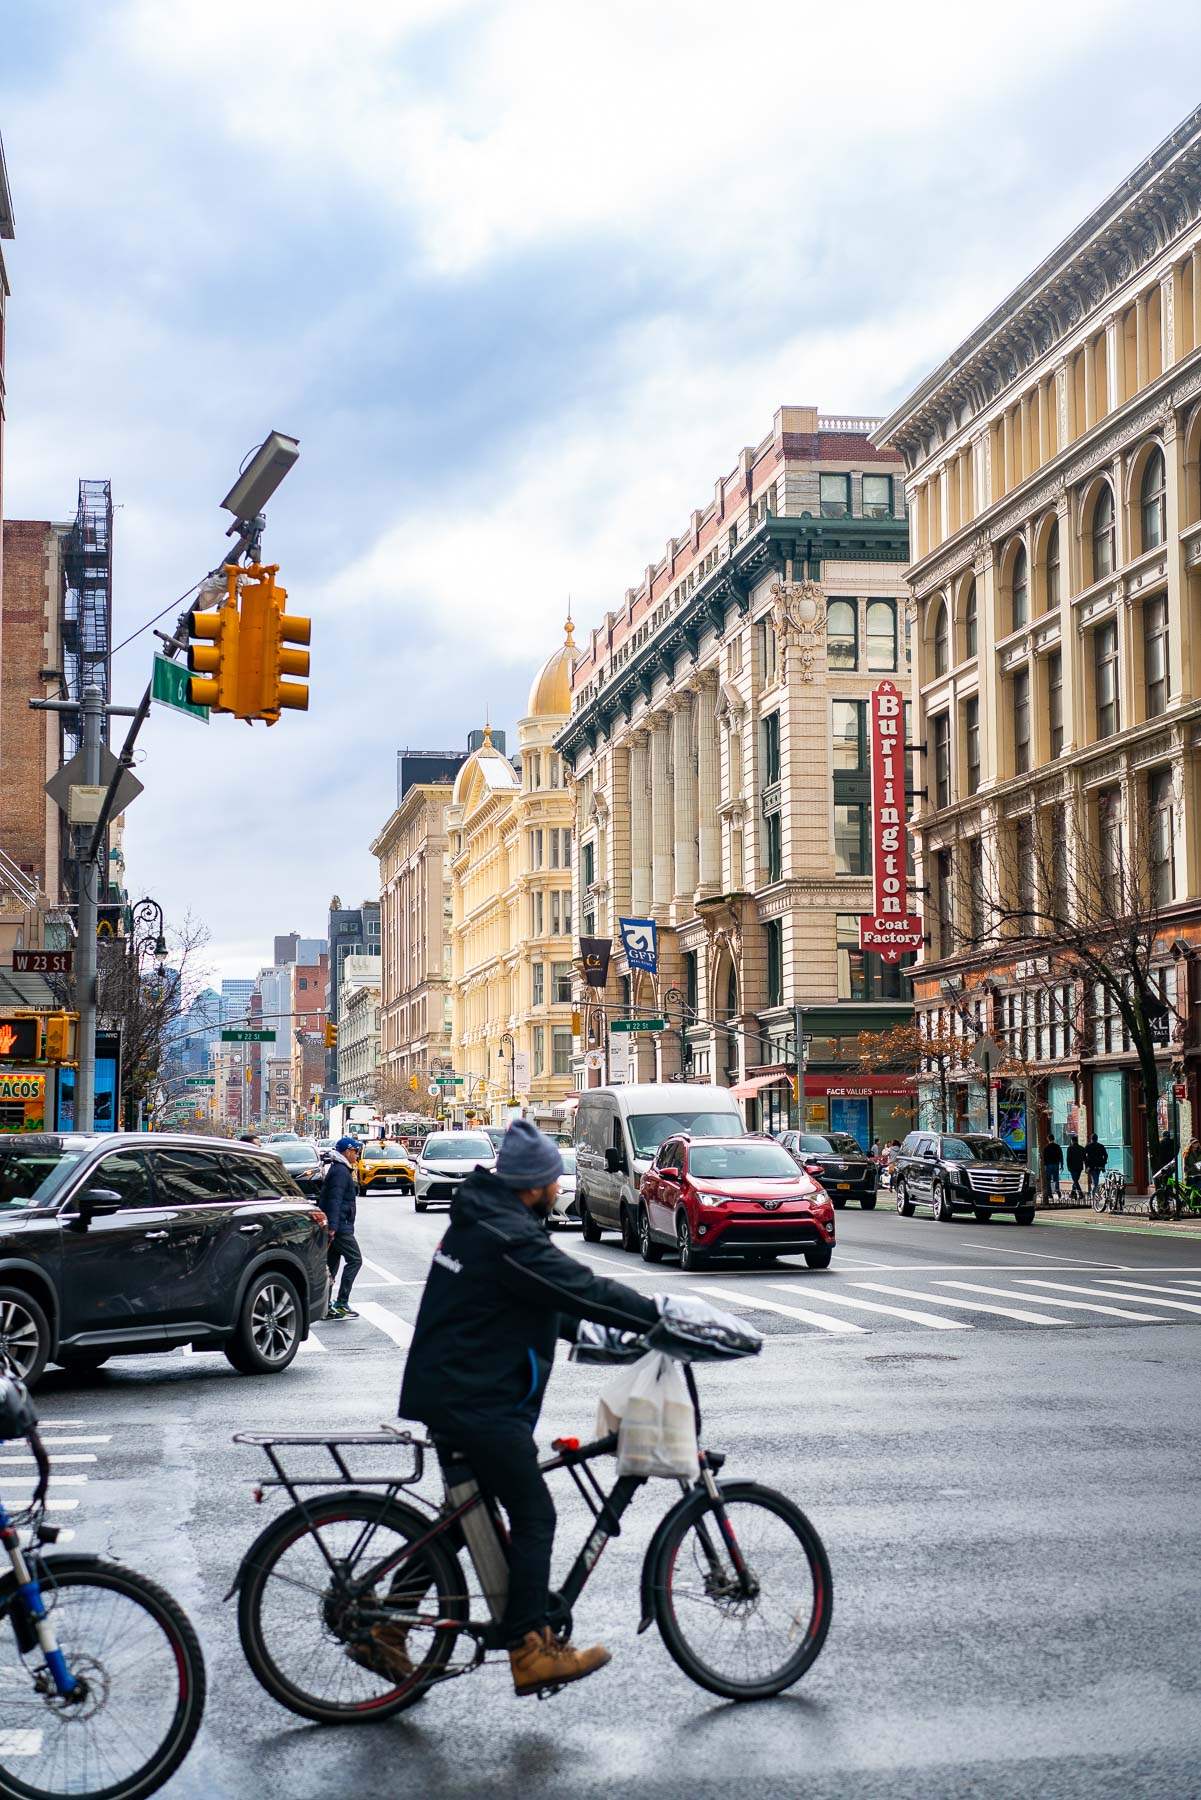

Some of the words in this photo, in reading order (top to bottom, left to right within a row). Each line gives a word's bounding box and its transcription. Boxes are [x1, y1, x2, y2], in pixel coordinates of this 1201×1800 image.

[178, 680, 183, 701] 6
[878, 695, 901, 913] Burlington
[874, 919, 909, 930] Coat
[863, 931, 921, 946] Factory
[628, 949, 655, 962] GFP
[16, 956, 28, 970] W
[33, 956, 47, 970] 23
[53, 956, 66, 970] St
